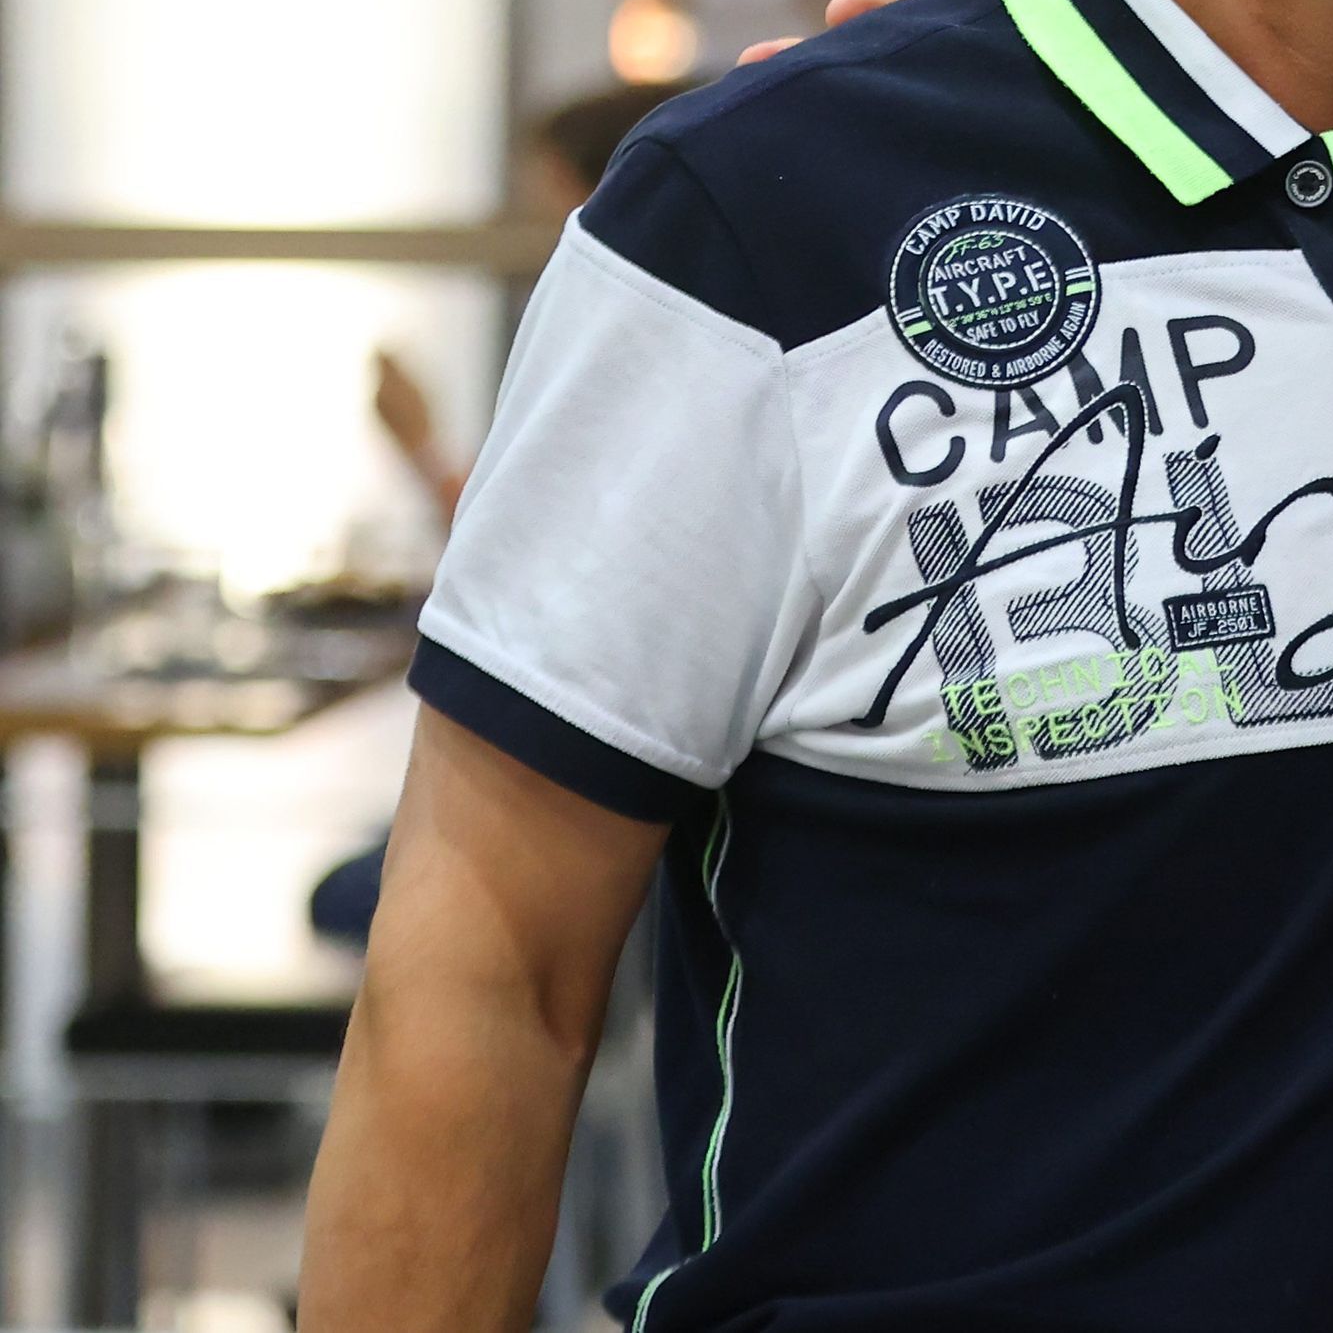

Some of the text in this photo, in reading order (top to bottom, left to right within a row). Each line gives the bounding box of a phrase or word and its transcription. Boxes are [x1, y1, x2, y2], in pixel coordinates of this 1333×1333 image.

[906, 204, 1046, 256] CAMP DAVID
[934, 246, 1028, 282] AIRCRAFT
[924, 300, 1086, 378] RESTORED & AIRBORNE AGAIN
[966, 310, 1039, 343] SAFE TO FLY
[874, 316, 1256, 489] CAMP
[1181, 596, 1259, 621] AIRBORNE
[940, 646, 1235, 721] TECHNICAL
[921, 679, 1245, 763] INSPECTION
